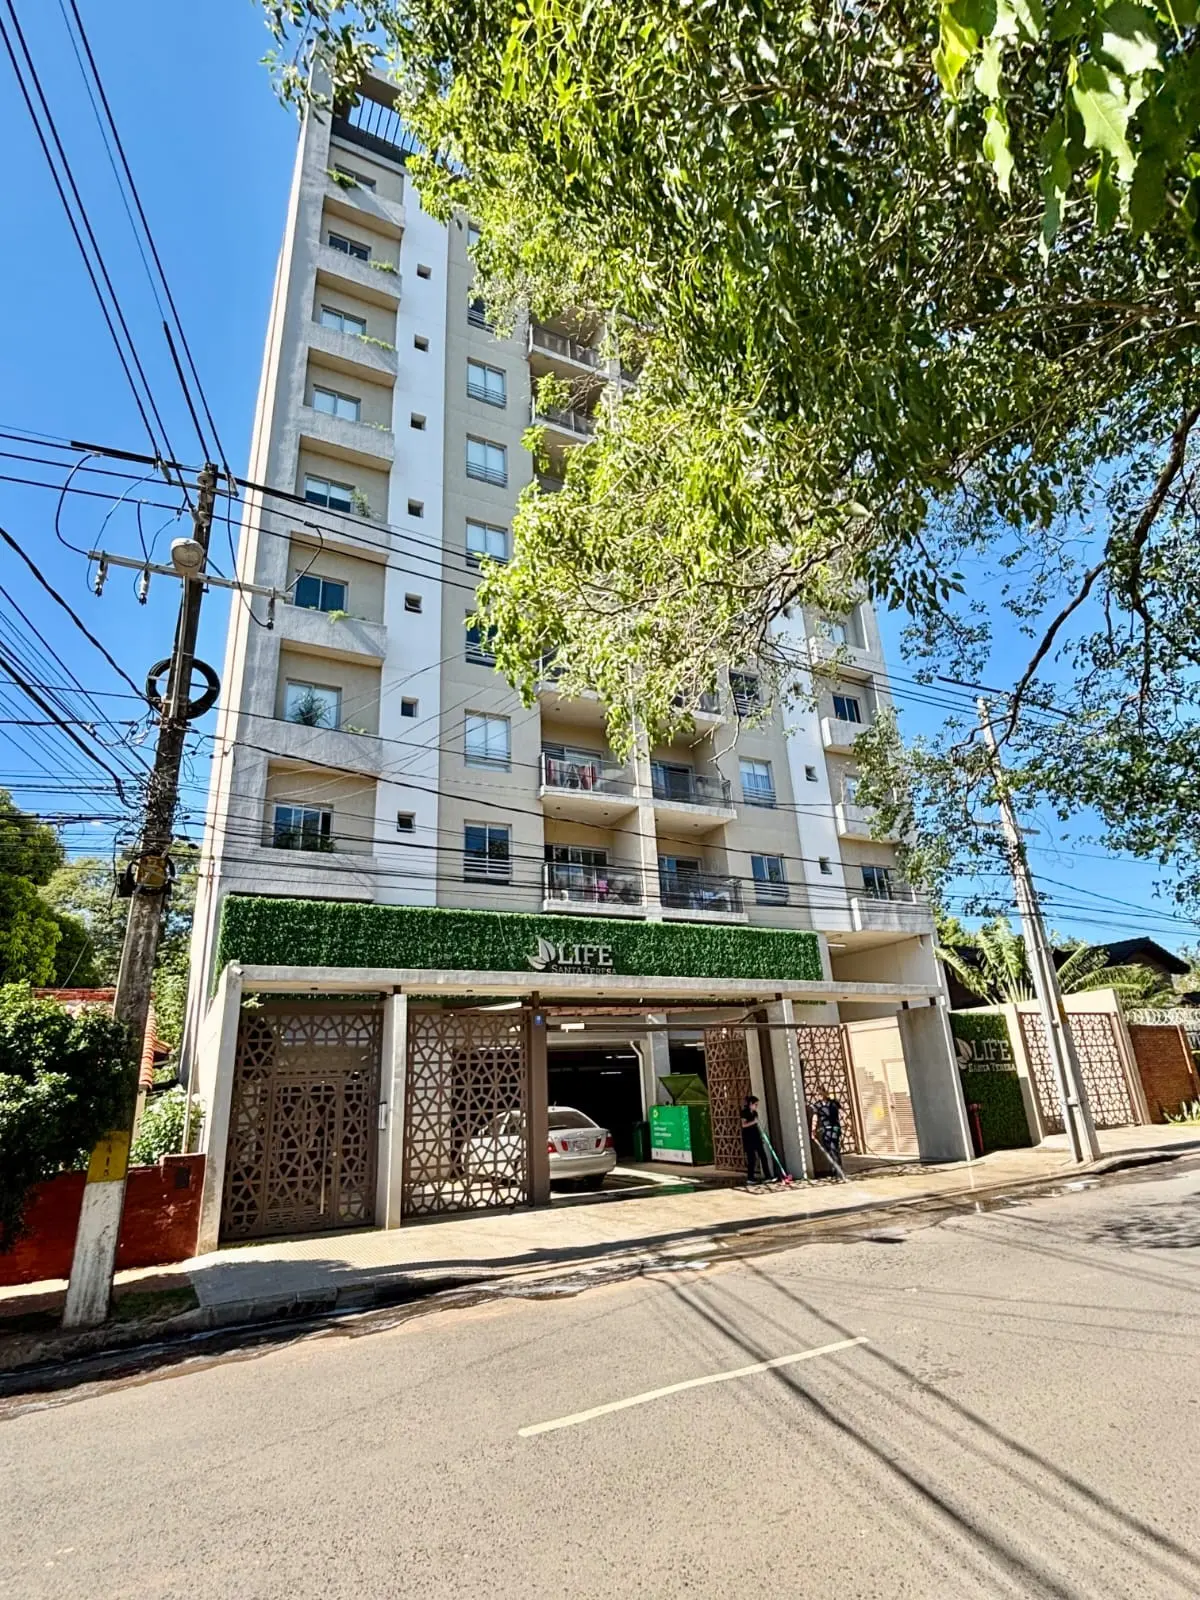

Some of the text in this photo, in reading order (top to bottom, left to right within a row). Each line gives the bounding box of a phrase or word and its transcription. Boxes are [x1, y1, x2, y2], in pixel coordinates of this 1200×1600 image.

[557, 943, 613, 966] LIFE
[551, 964, 617, 976] SANTA TERESA
[970, 1039, 1011, 1061] LIFE
